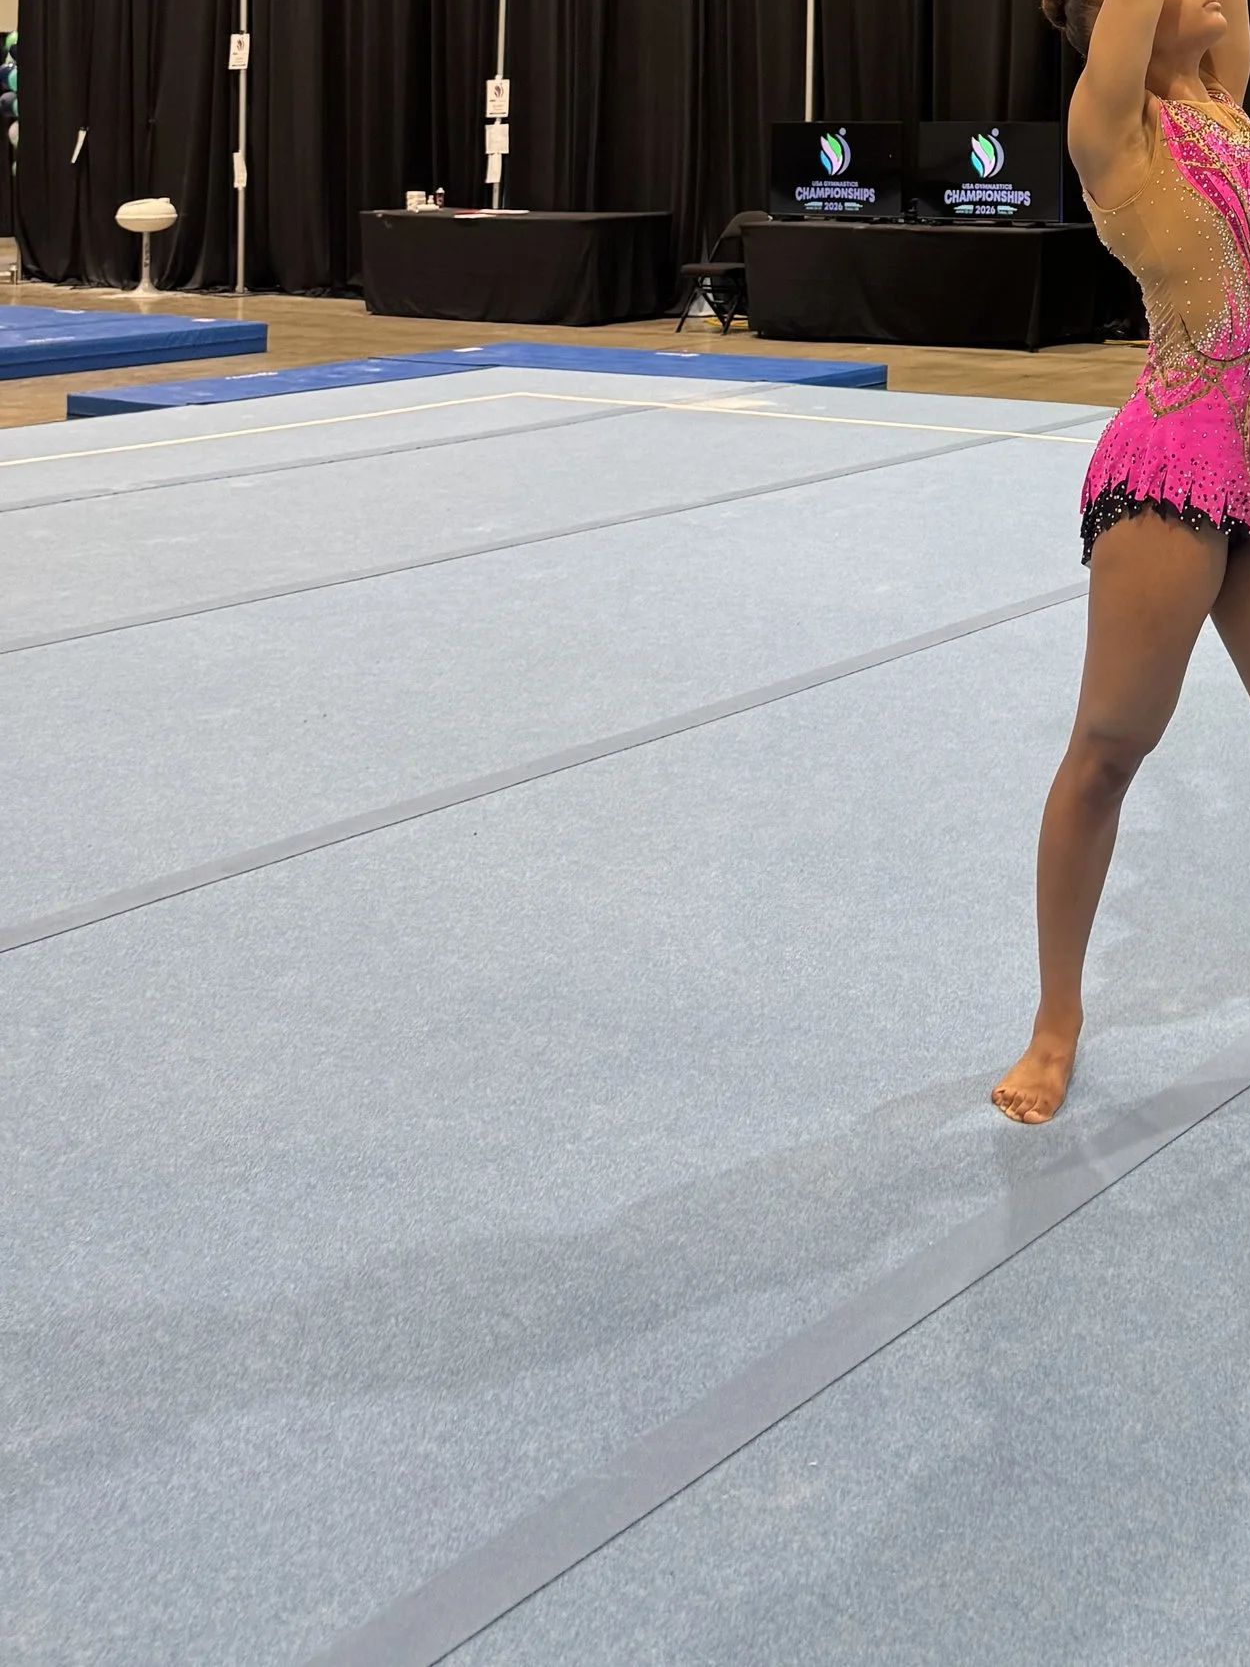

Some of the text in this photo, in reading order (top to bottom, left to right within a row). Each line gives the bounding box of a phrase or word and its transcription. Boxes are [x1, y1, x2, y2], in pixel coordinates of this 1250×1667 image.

[795, 187, 875, 202] CHAMPIONSHIPS
[944, 189, 1031, 206] CHAMPIONSHIPS
[824, 202, 843, 211] 2026
[975, 205, 996, 214] 2026
